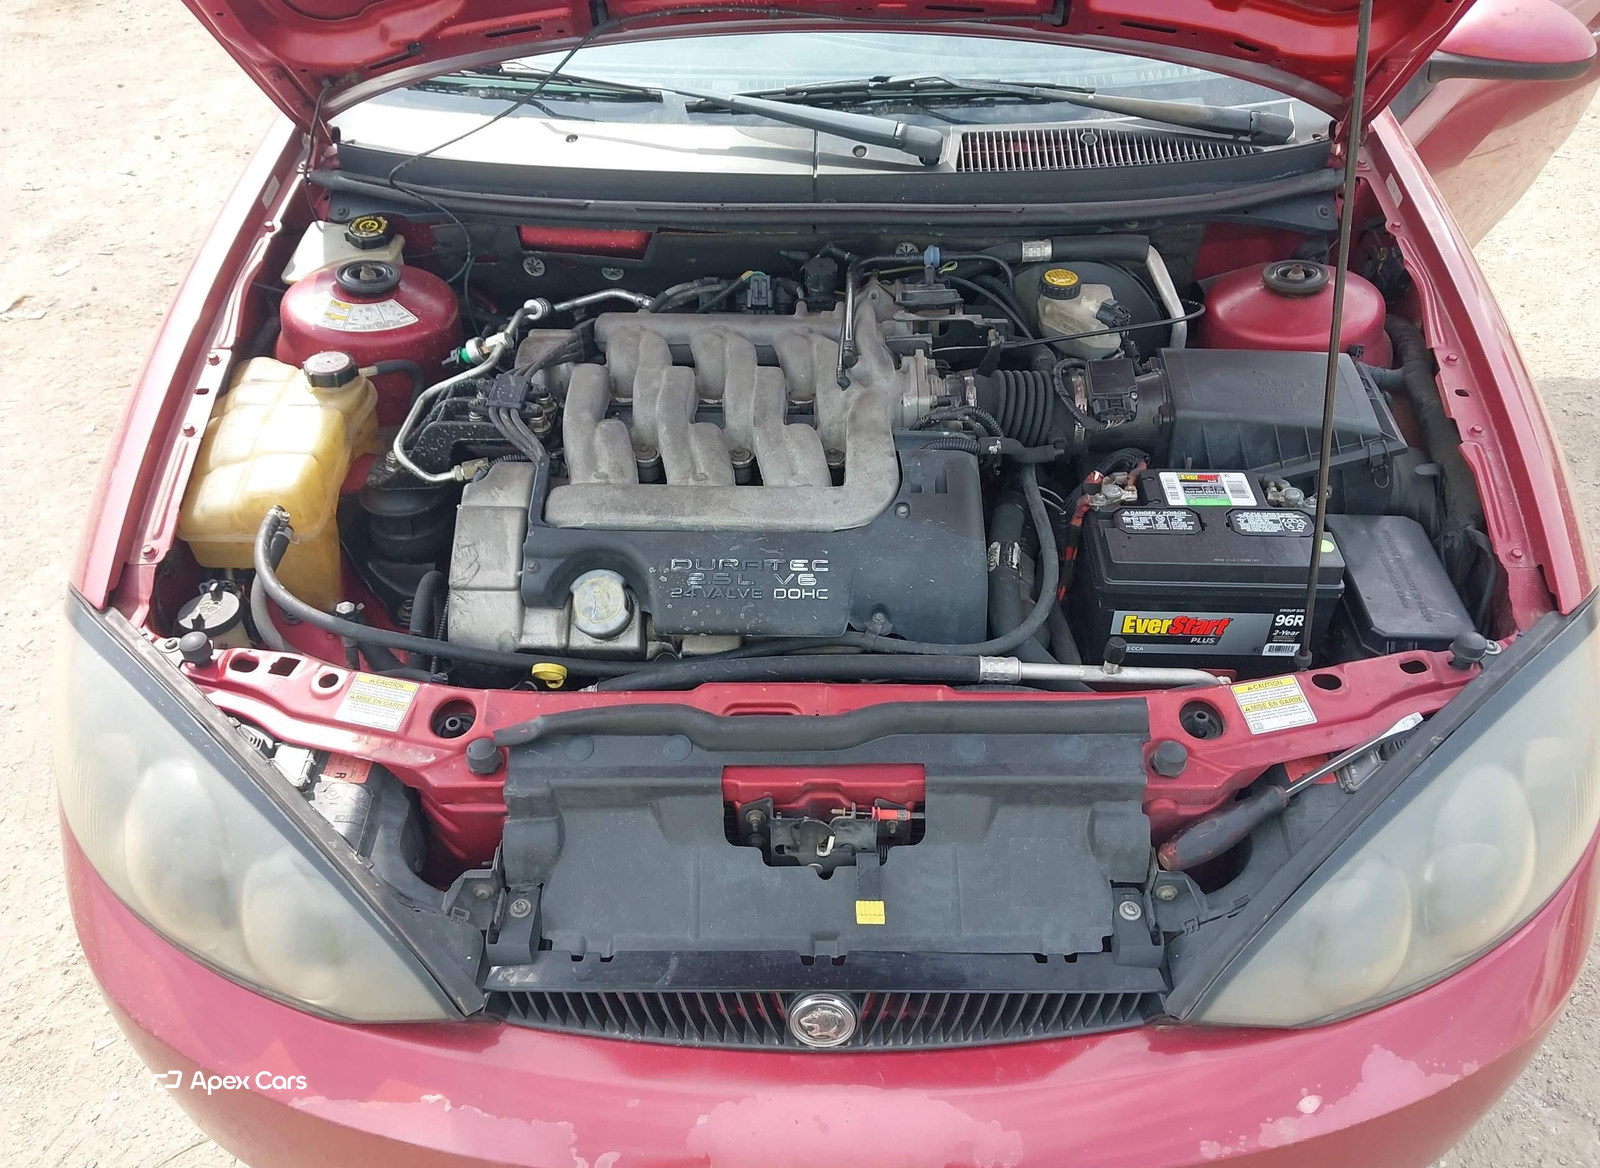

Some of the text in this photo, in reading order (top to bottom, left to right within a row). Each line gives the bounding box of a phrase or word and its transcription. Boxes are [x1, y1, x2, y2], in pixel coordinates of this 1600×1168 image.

[670, 558, 829, 572] DURATEC
[774, 573, 817, 586] V6
[773, 588, 829, 600] DOHC
[1121, 615, 1232, 635] EverStart
[1275, 614, 1304, 626] 96R
[376, 680, 405, 689] CAUTION
[1253, 680, 1282, 690] CAUTION
[356, 695, 371, 703] MISE
[383, 700, 406, 709] GARDE
[1250, 702, 1267, 710] MISE
[1279, 696, 1303, 705] GARDE
